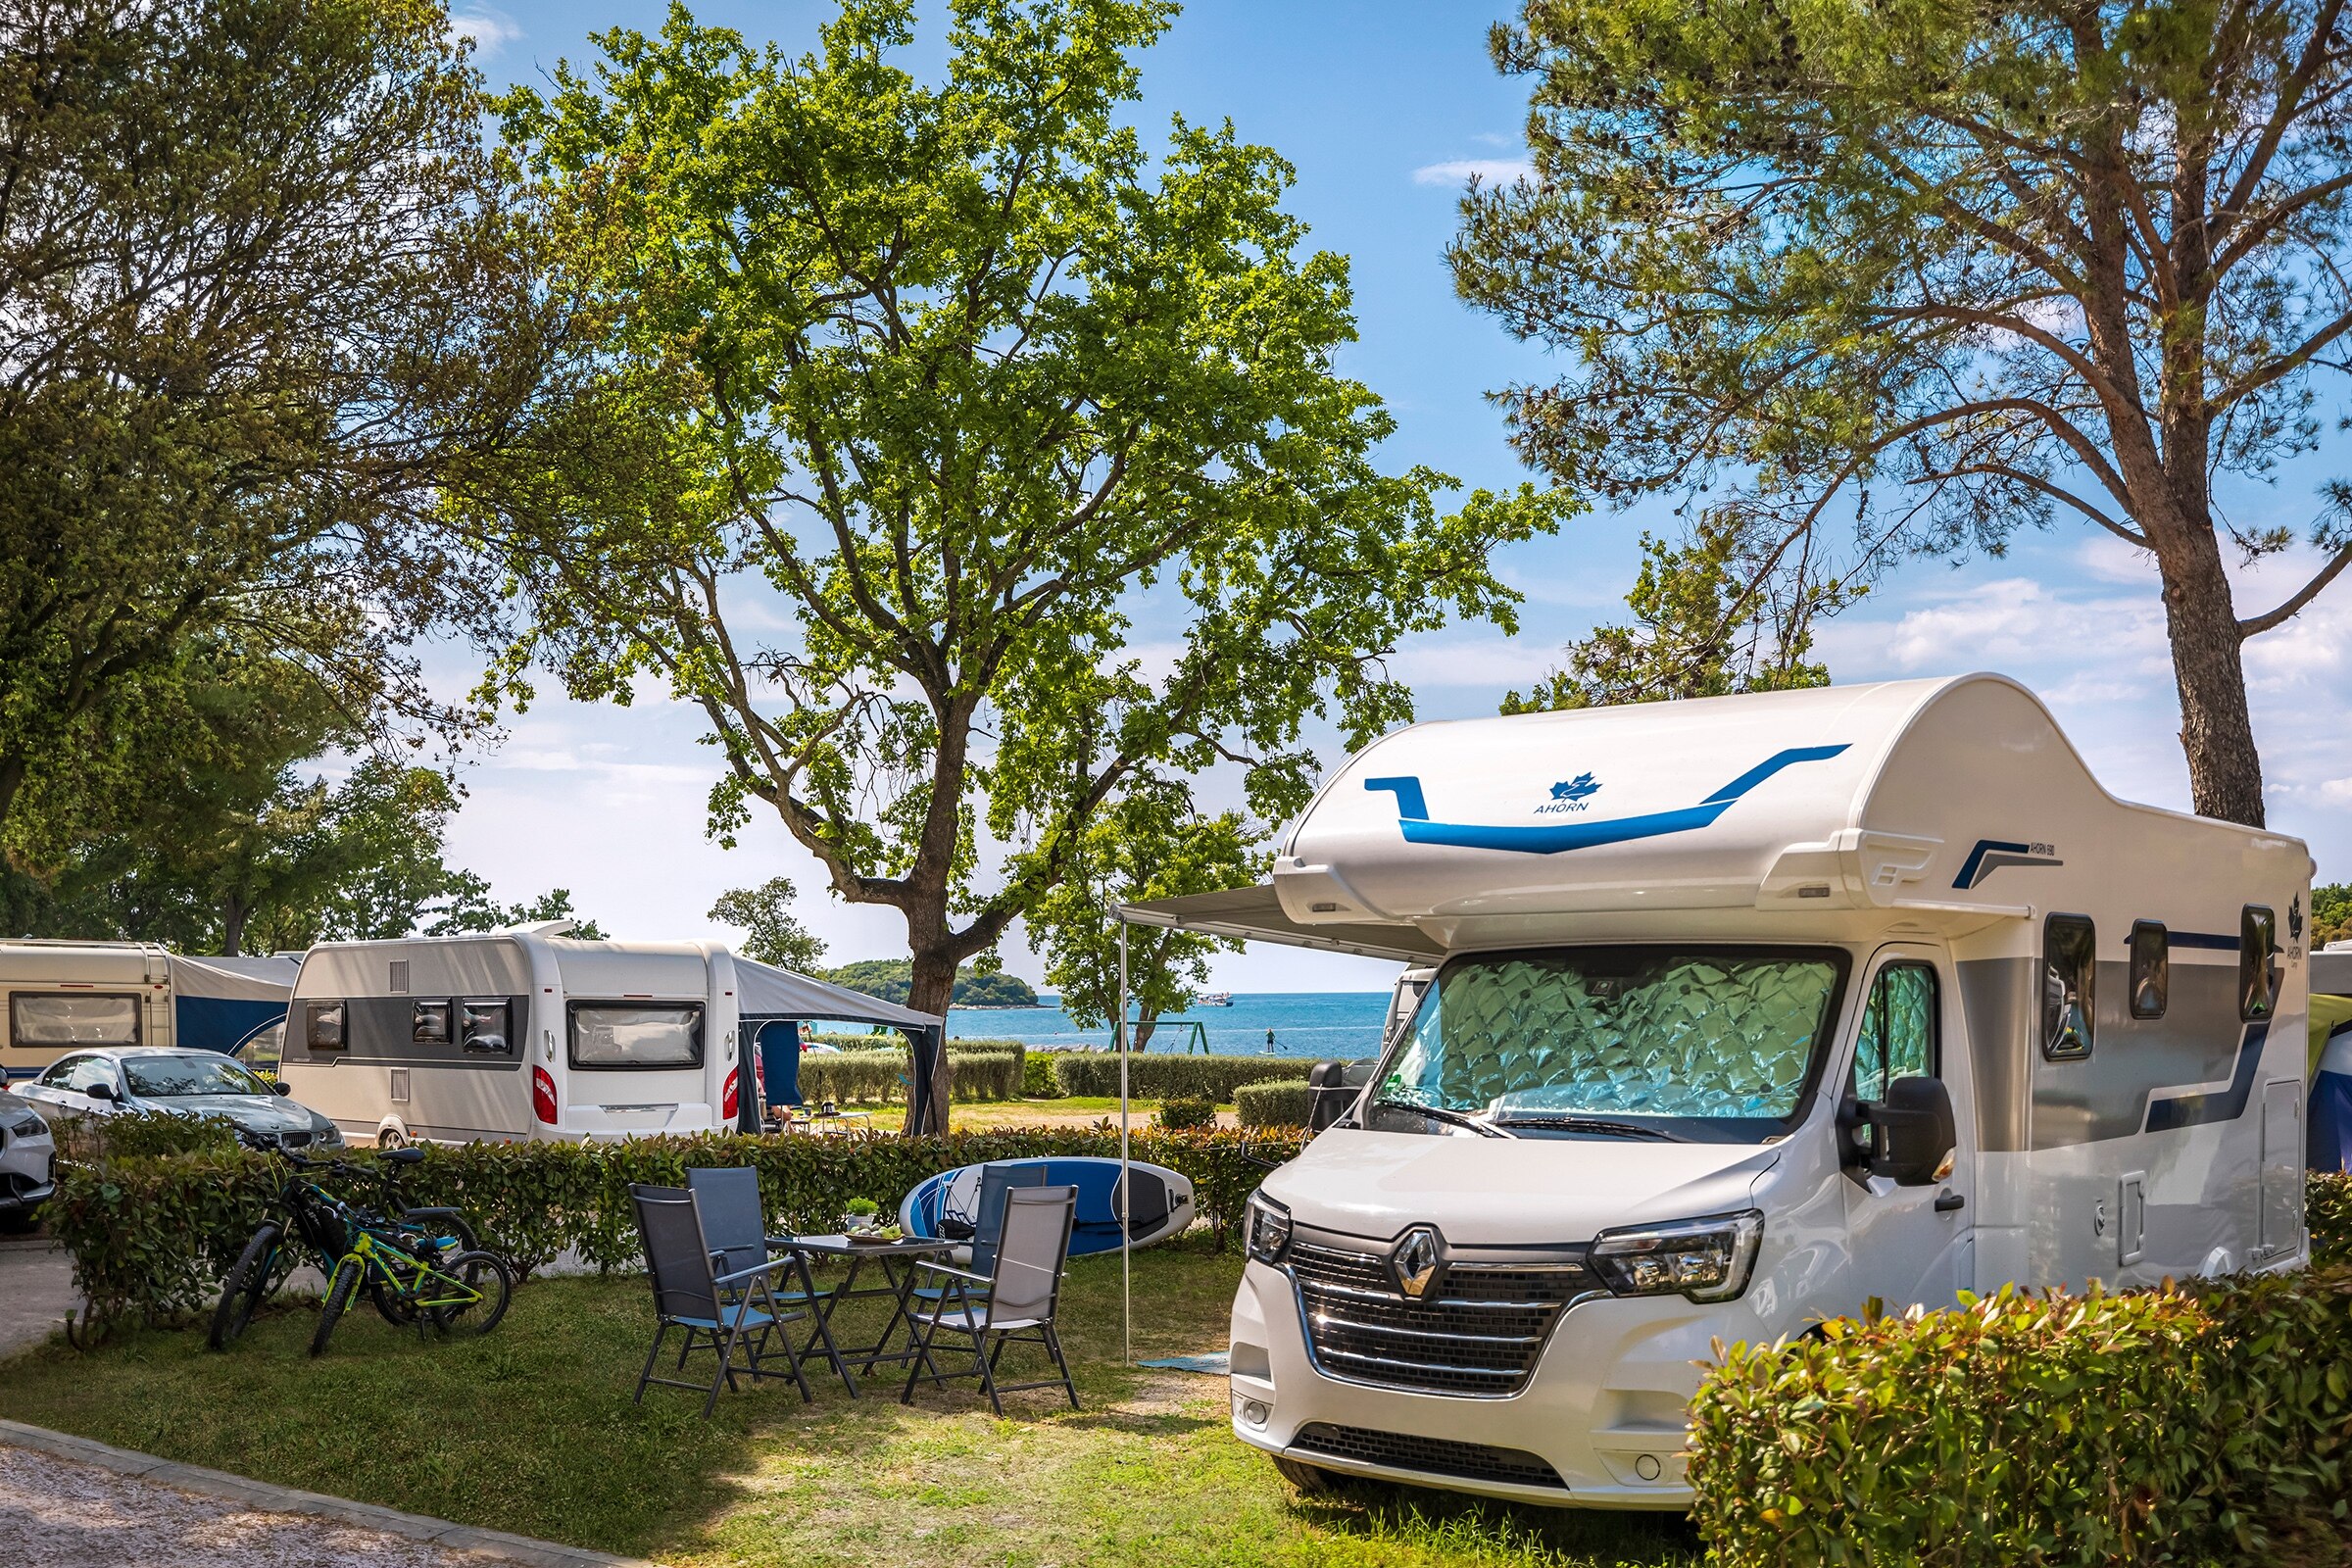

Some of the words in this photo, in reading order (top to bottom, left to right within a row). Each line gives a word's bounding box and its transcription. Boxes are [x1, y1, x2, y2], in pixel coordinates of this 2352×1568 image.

[1533, 802, 1590, 814] AHORN
[2030, 842, 2046, 855] AHORN
[2287, 946, 2302, 959] AHORN
